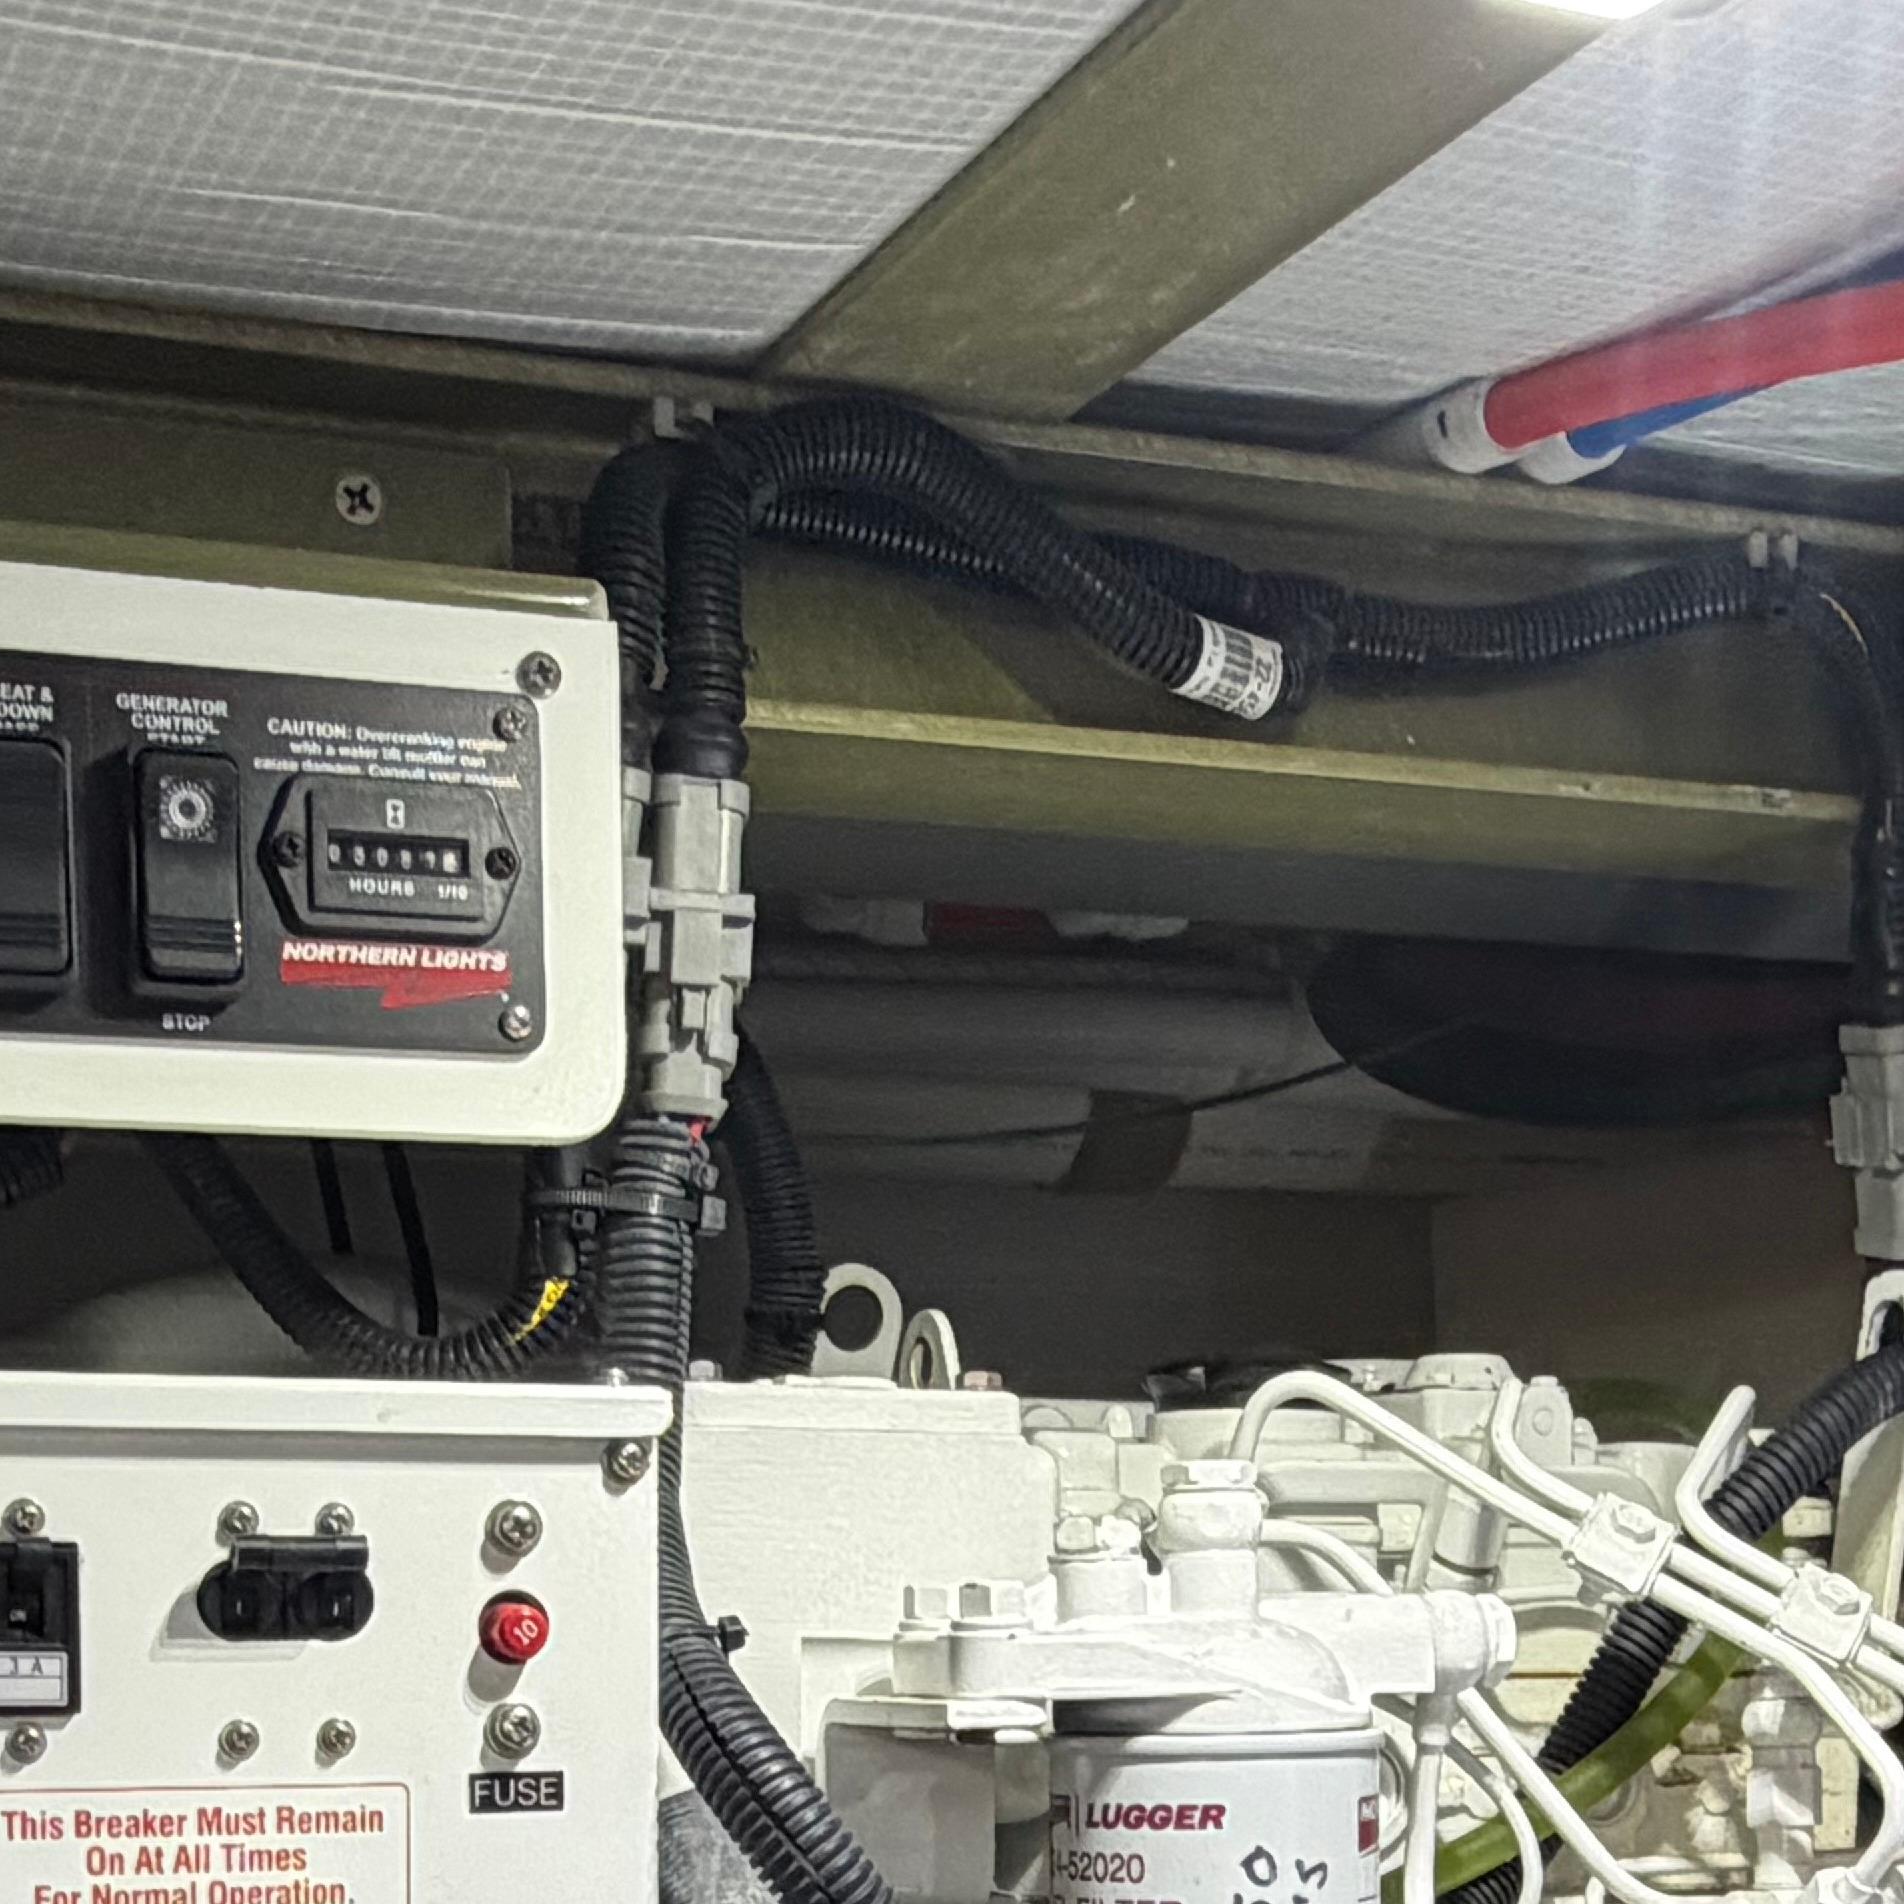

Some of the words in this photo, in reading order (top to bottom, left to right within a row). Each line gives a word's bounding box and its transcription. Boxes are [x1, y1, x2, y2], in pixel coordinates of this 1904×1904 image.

[40, 686, 54, 703] &
[116, 693, 229, 717] GENERATOR
[130, 712, 221, 736] CONTROL
[266, 716, 352, 741] CAUTION:
[355, 726, 455, 751] Overcranking
[289, 740, 323, 757] with
[338, 744, 379, 760] water
[404, 749, 457, 766] muffler
[459, 754, 486, 770] can
[367, 762, 427, 782] Consult
[348, 877, 416, 898] HOURS
[282, 941, 417, 969] NORTHERN
[420, 947, 510, 973] LIGHTS
[162, 1011, 212, 1033] STOP
[509, 1617, 540, 1645] 10
[474, 1776, 560, 1808] FUSE
[1, 1809, 65, 1842] This
[73, 1808, 188, 1840] Breaker
[196, 1805, 268, 1838] Must
[275, 1804, 385, 1836] Remain
[1086, 1802, 1227, 1831] LUGGER
[85, 1845, 126, 1878] On
[134, 1845, 165, 1877] At
[174, 1844, 211, 1875] All
[220, 1842, 308, 1874] Times
